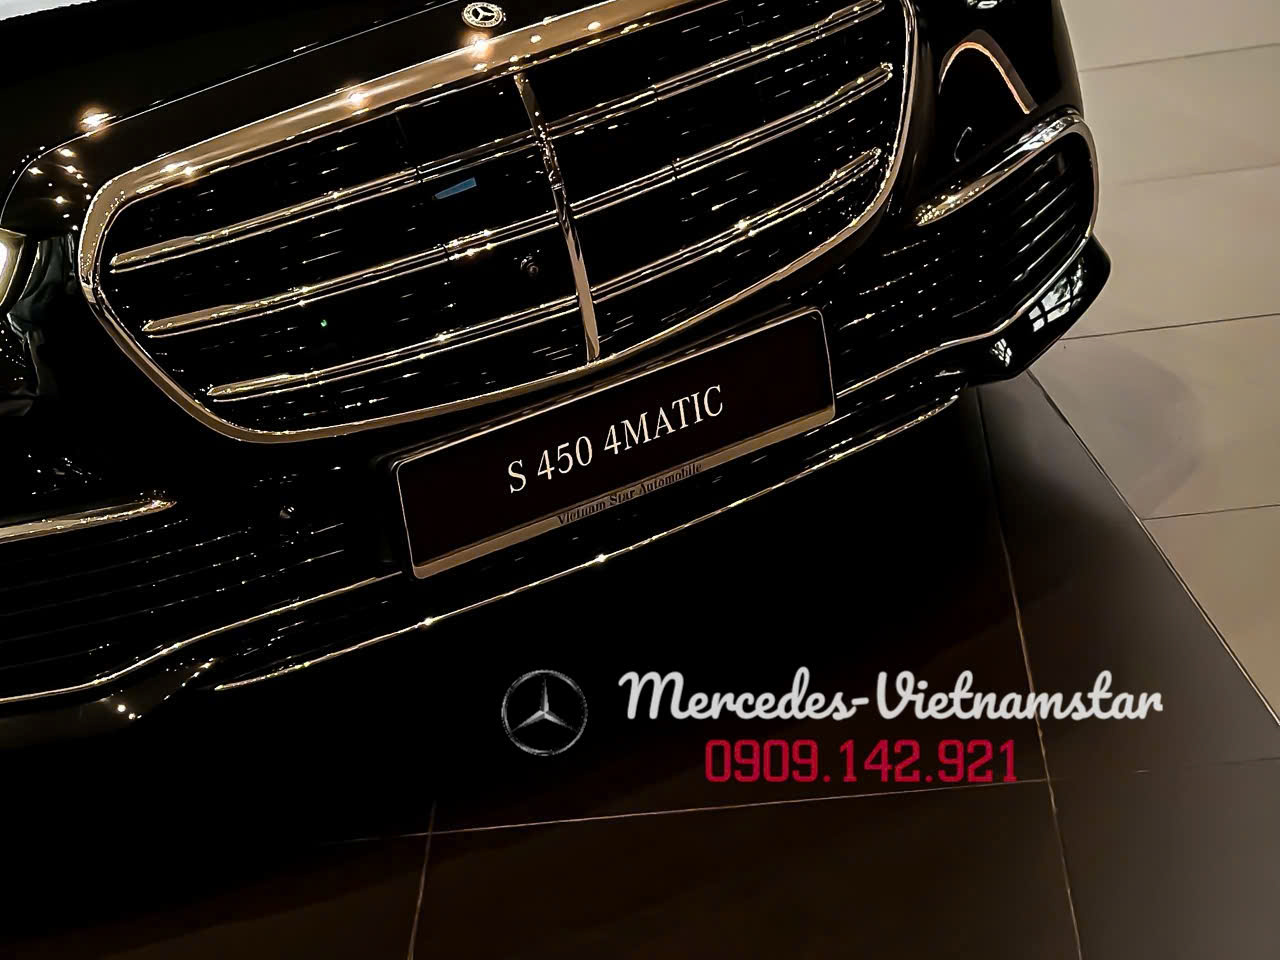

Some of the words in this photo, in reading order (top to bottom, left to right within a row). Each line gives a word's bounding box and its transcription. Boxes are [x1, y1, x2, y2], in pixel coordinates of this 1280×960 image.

[508, 460, 527, 494] S
[537, 436, 593, 480] 450
[604, 384, 723, 455] 4MATIC
[557, 499, 607, 525] Vietnam
